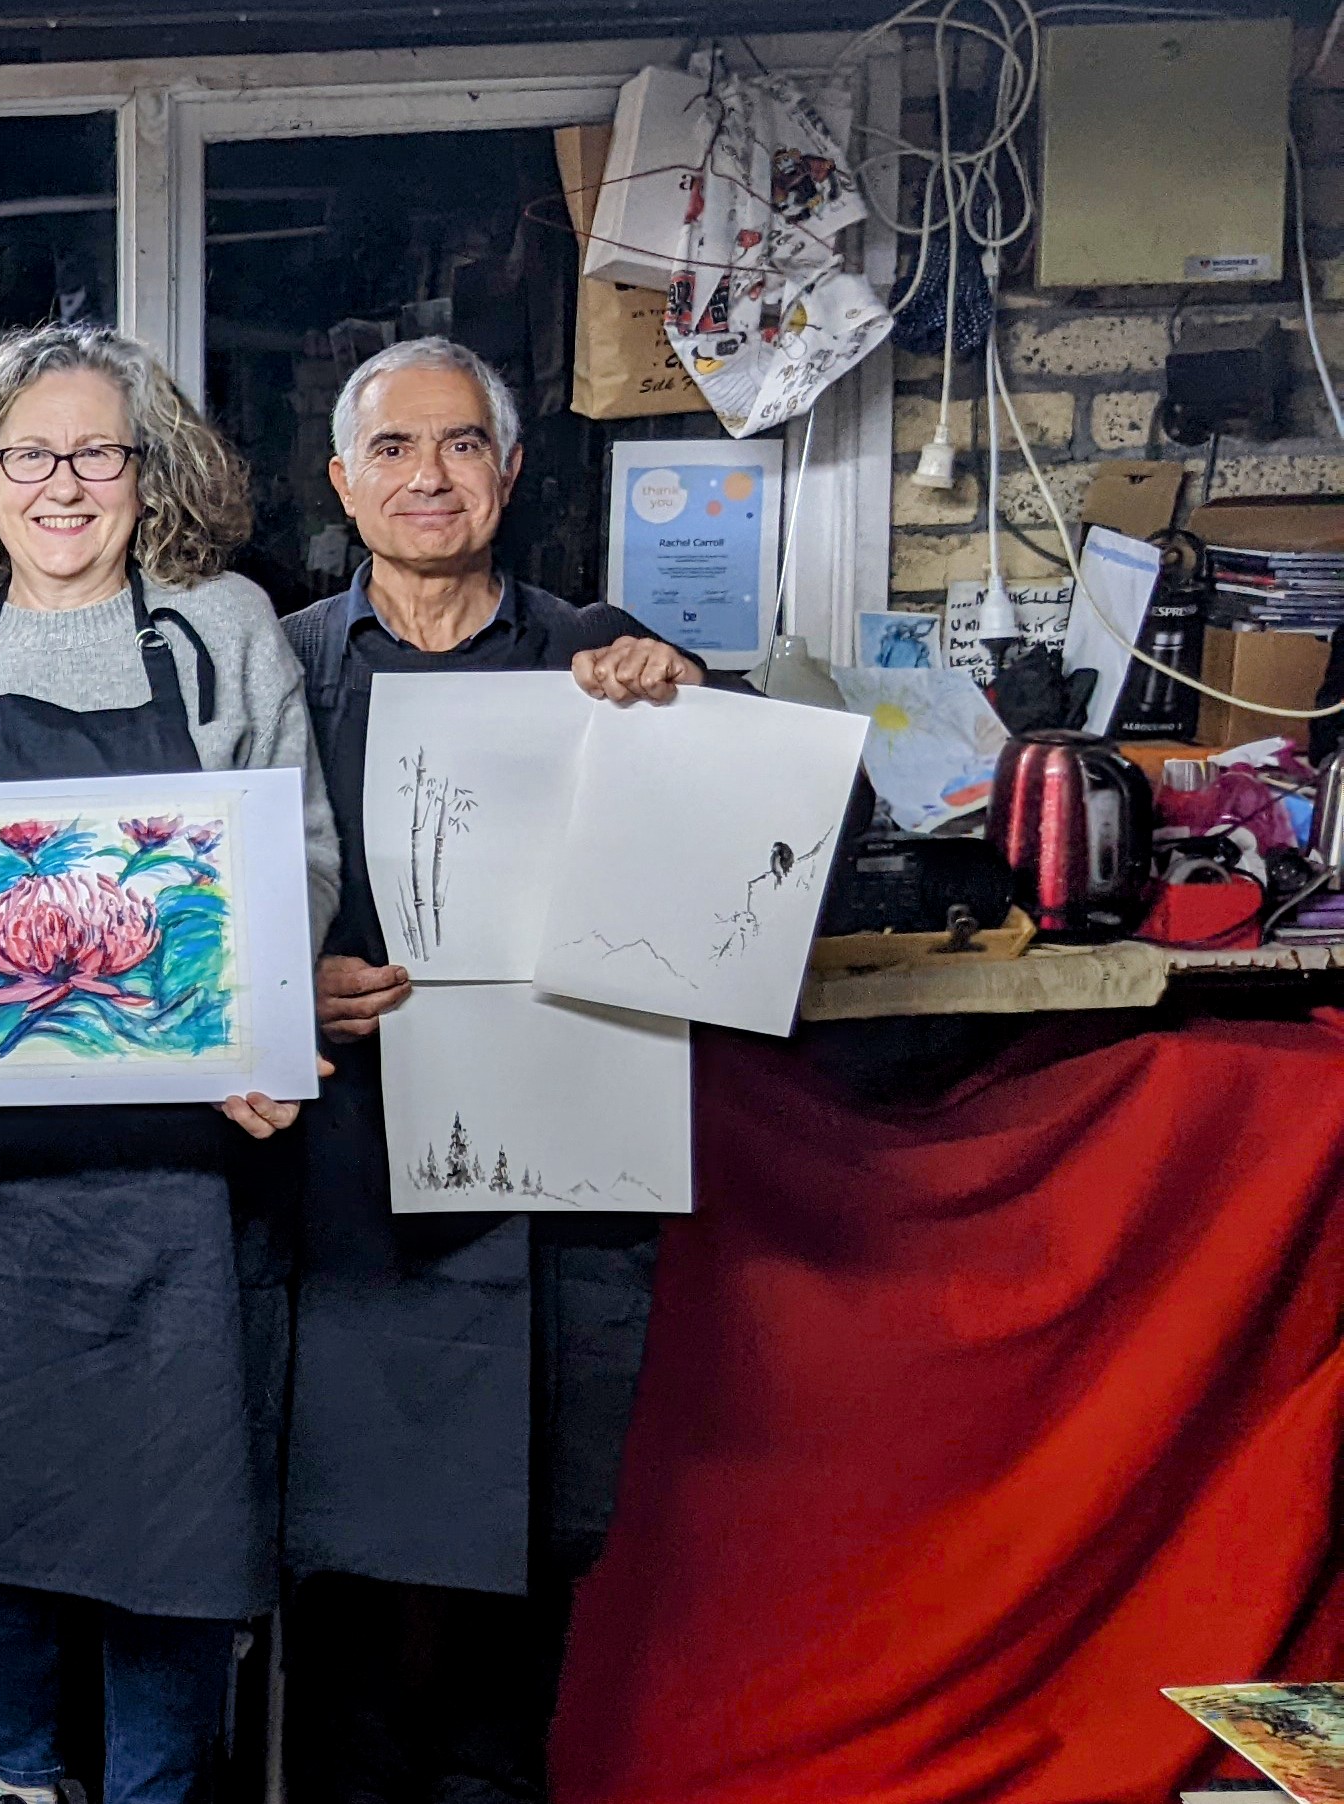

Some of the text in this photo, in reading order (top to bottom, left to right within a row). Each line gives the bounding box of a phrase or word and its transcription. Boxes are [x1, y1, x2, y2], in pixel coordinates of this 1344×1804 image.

[638, 377, 677, 394] Silk
[642, 484, 680, 495] thank
[649, 499, 673, 509] you
[659, 538, 725, 547] Rachel Carroll
[683, 609, 697, 622] be
